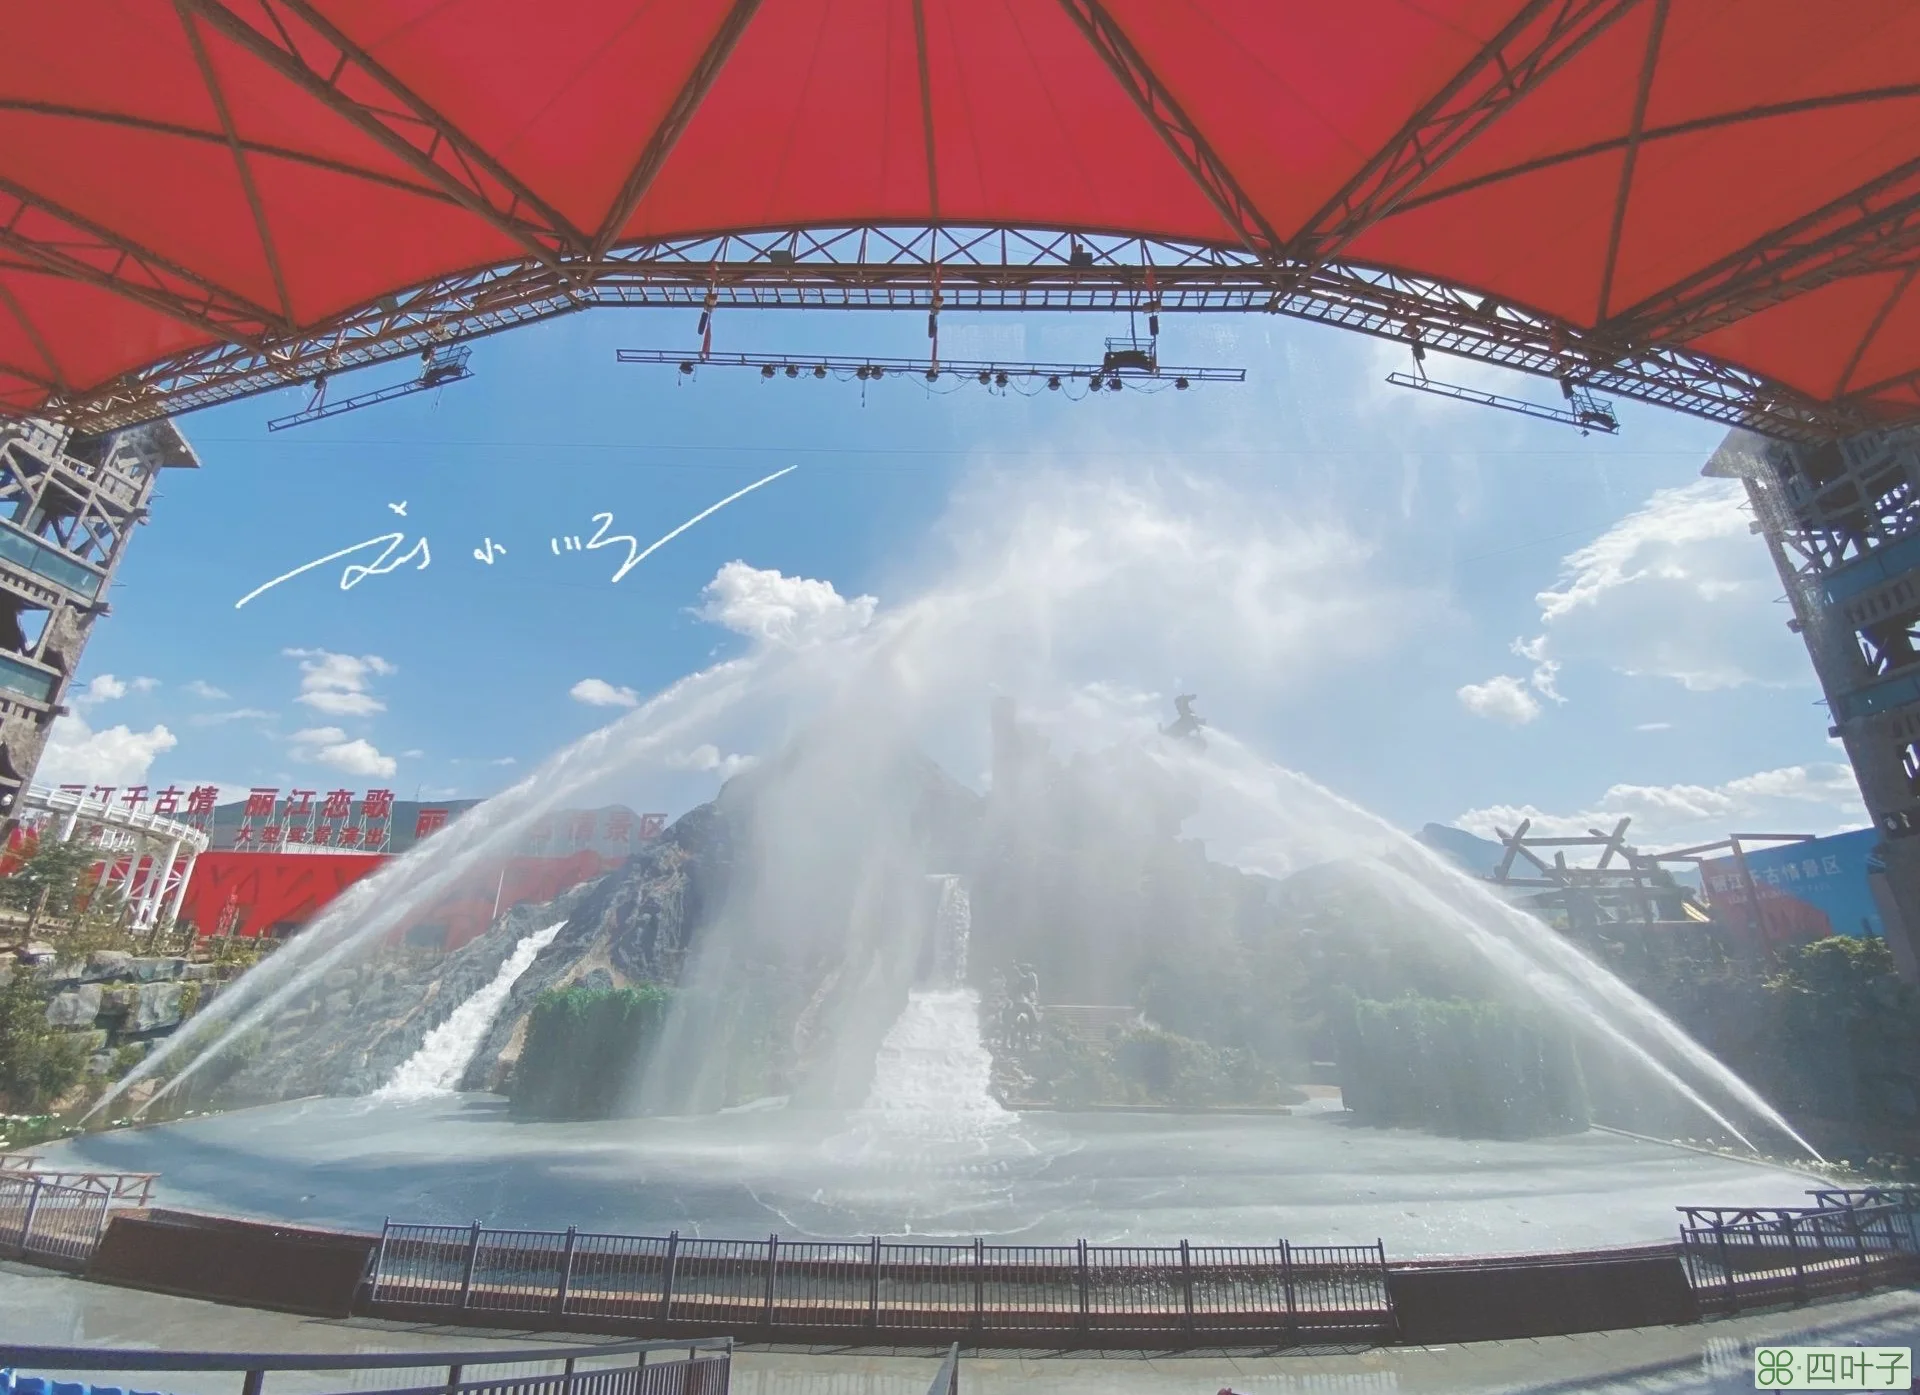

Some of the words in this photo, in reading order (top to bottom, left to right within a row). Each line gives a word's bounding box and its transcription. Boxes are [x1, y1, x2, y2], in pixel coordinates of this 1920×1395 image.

[244, 788, 395, 818] 丽江恋歌
[415, 809, 668, 842] 丽情景区
